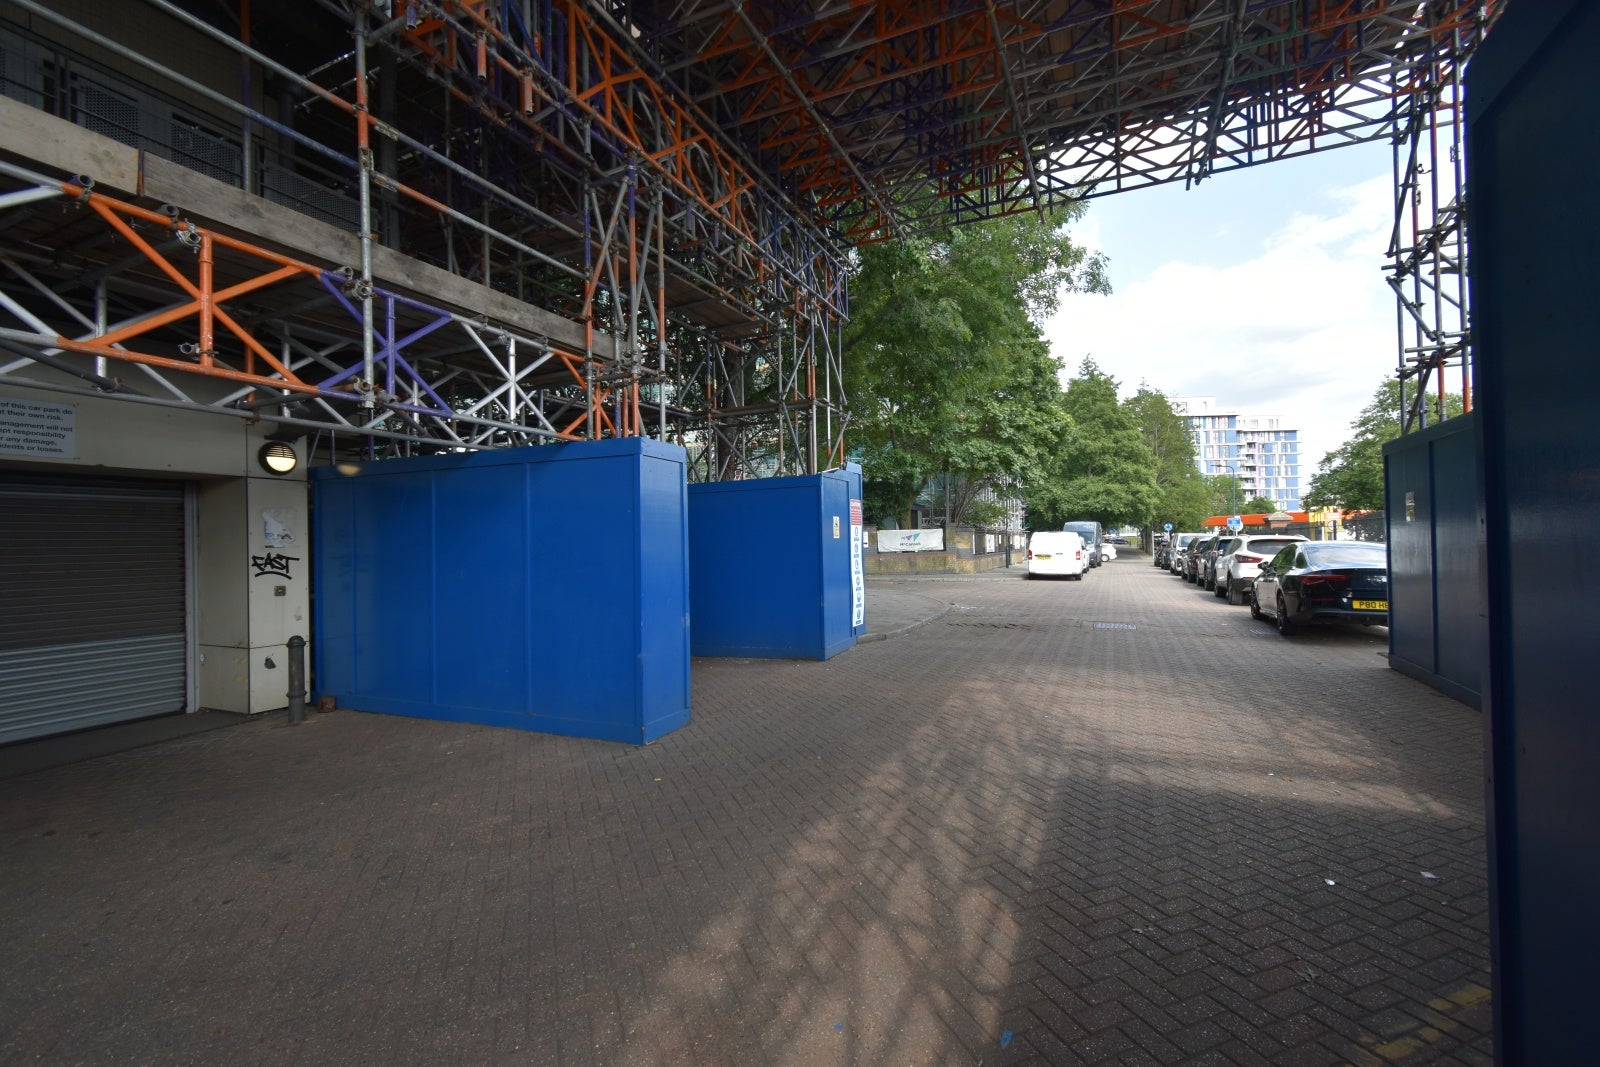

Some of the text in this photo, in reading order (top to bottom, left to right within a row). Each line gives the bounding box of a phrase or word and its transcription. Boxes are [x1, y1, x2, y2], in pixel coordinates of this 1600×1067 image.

[11, 402, 26, 410] this
[7, 409, 26, 417] their
[13, 429, 66, 440] responsibility
